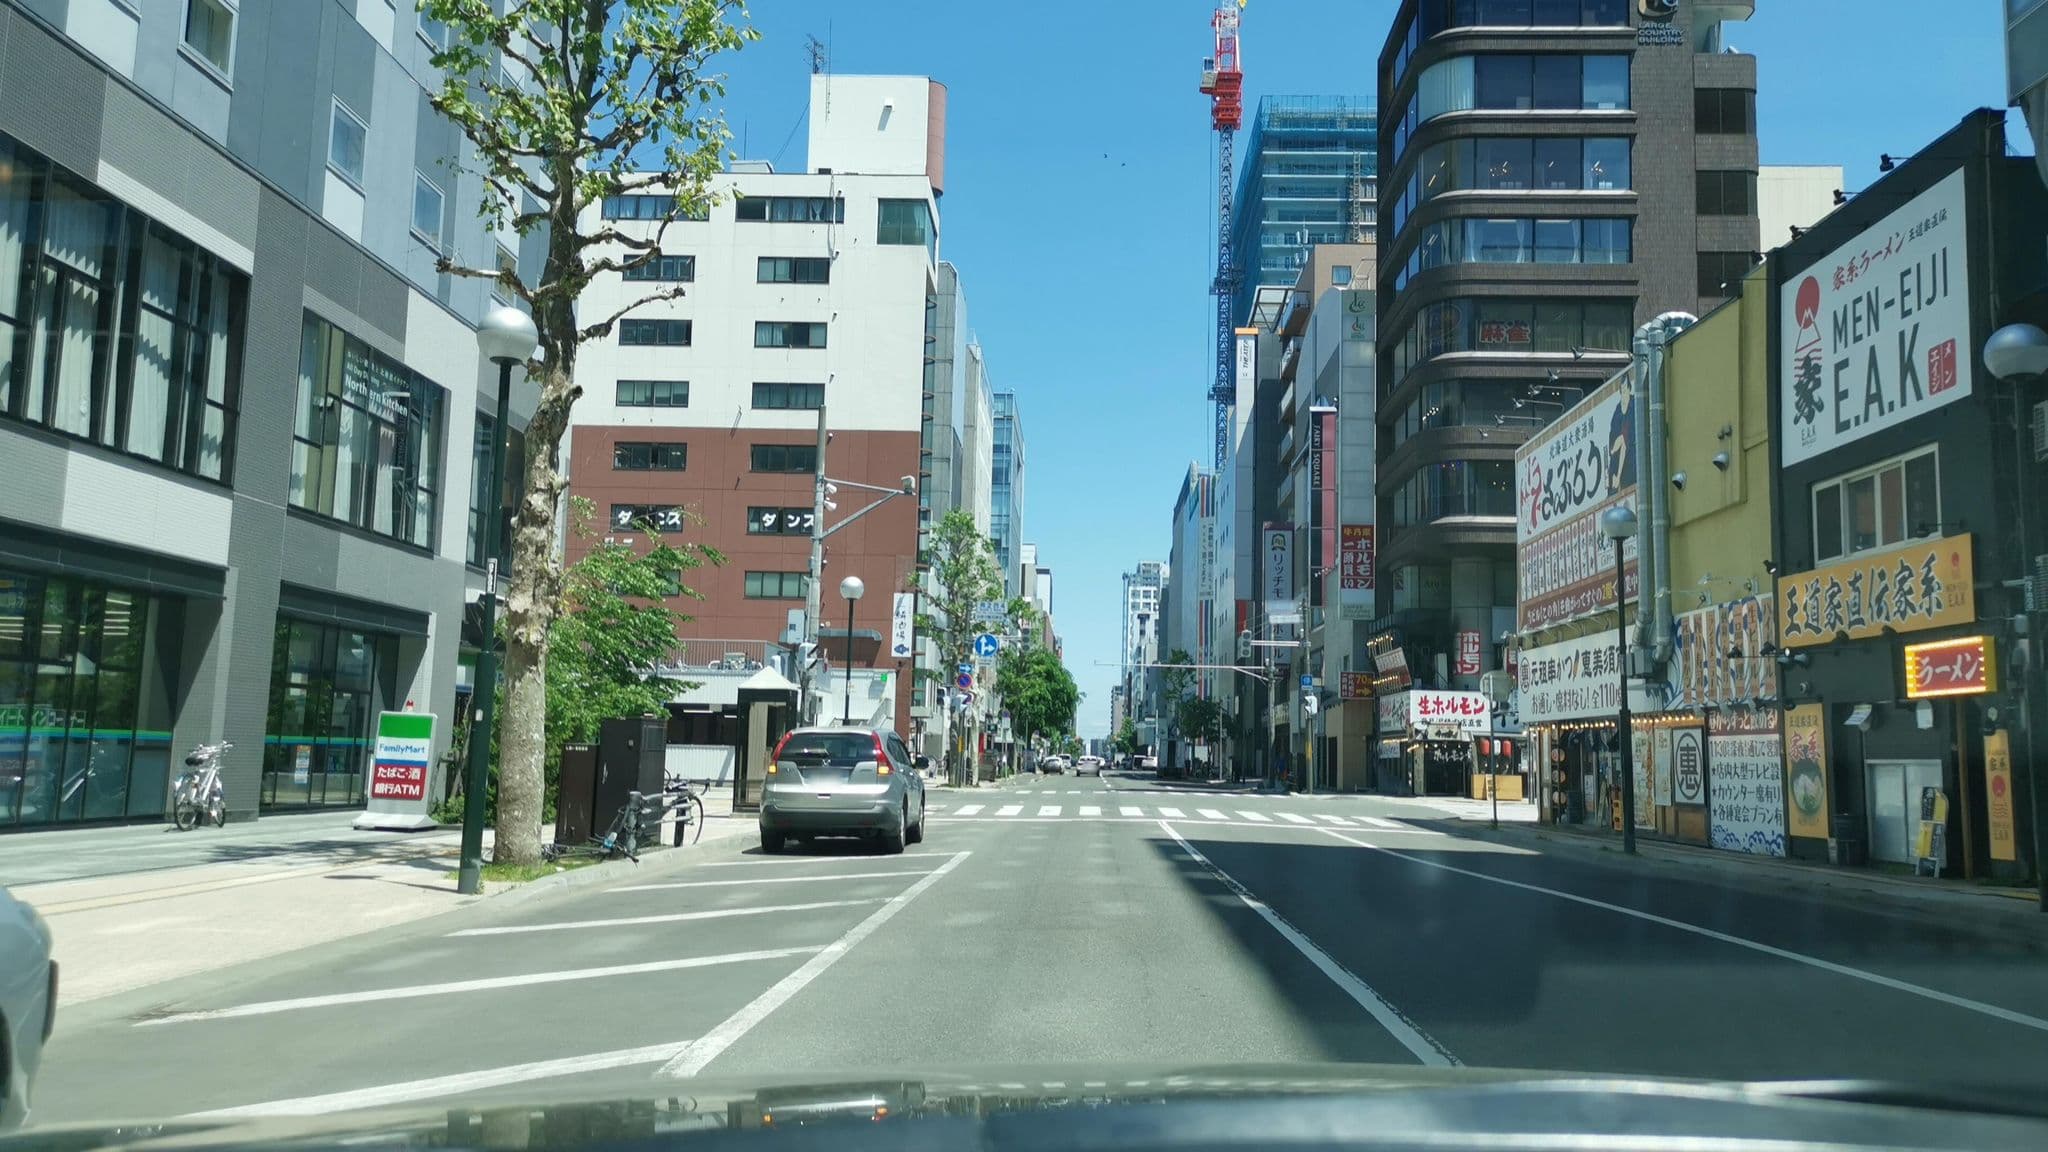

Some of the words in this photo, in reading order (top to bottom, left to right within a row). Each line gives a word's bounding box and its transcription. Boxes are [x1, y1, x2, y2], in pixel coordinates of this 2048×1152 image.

[1831, 231, 1906, 291] 家系ラーメン
[1833, 247, 1949, 354] MEN-EIJI
[1834, 322, 1924, 434] E.A.K
[1273, 553, 1284, 600] リッチモ
[1356, 538, 1372, 589] ホルモン
[1784, 551, 1944, 639] 王道家直伝家系
[1531, 655, 1573, 687] 元祖串かつ
[1920, 653, 1978, 686] ラーメン
[1418, 695, 1485, 715] 生ホルモン
[380, 744, 425, 754] FamilyMart
[375, 782, 421, 796] 銀行ATM
[377, 766, 421, 780] たばこ・酒
